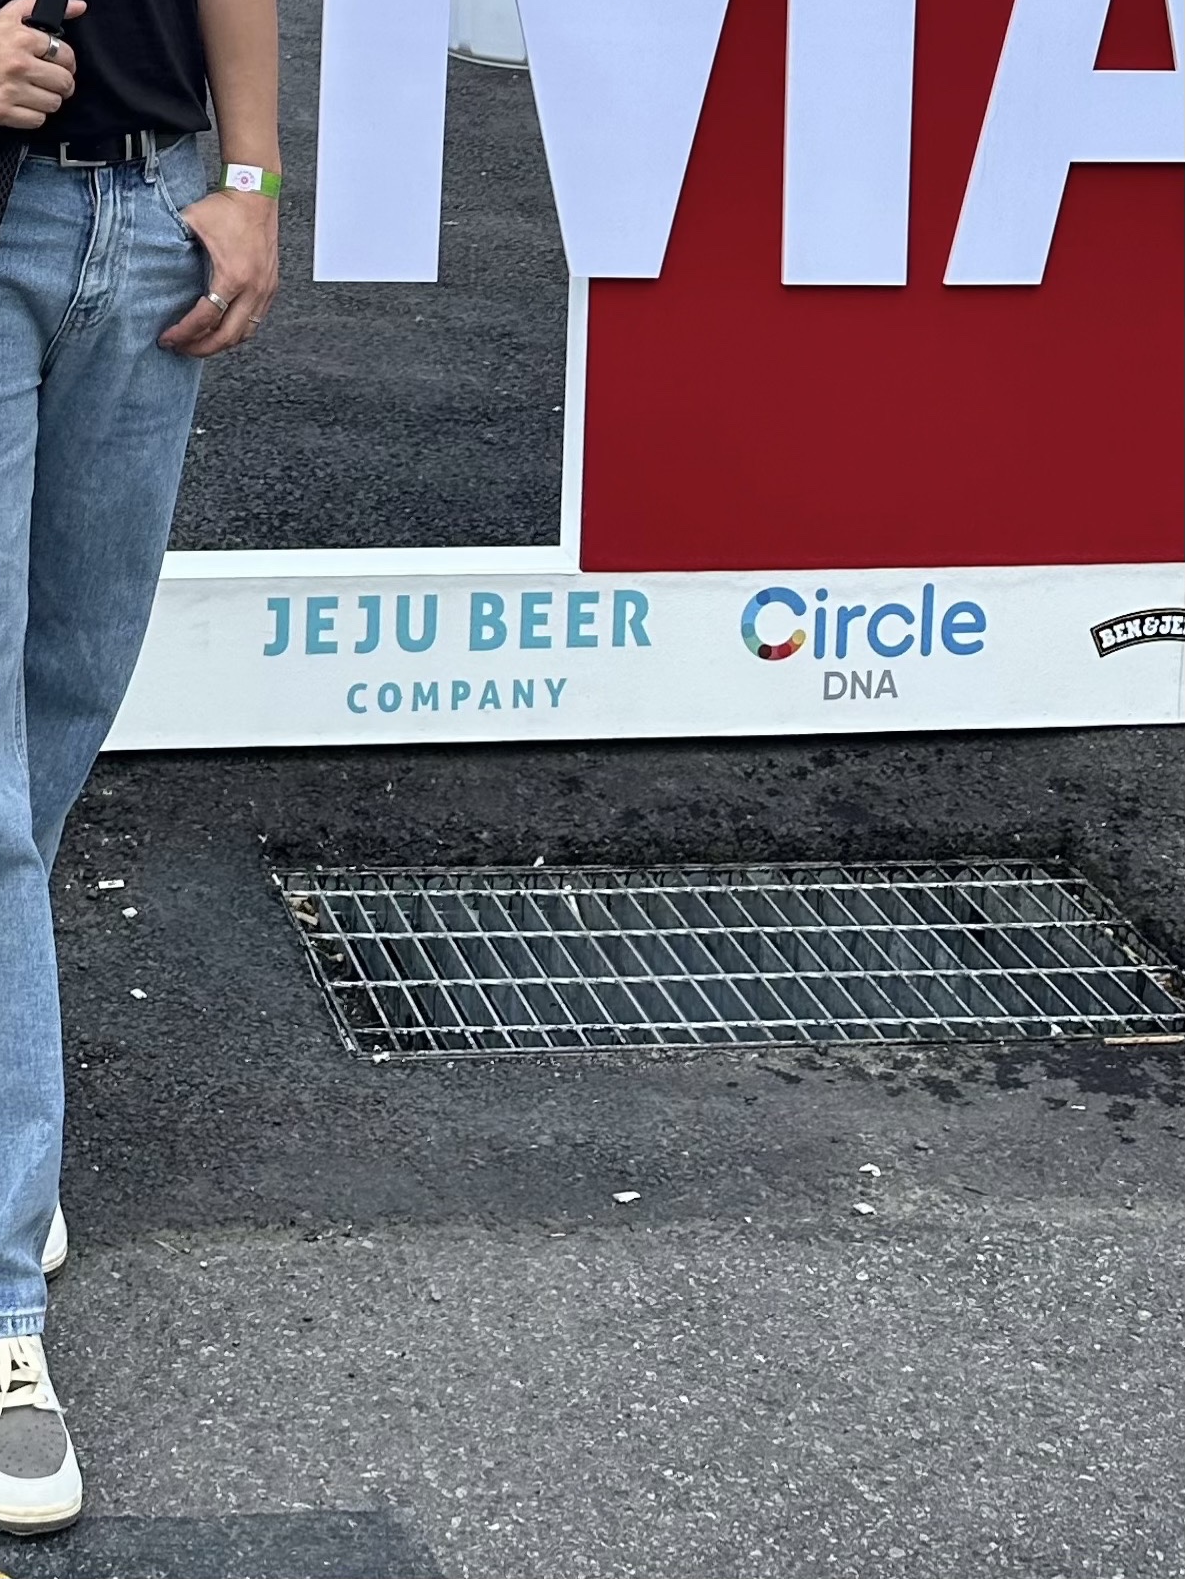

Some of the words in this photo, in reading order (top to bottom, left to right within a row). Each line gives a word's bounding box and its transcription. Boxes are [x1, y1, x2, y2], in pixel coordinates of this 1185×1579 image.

[263, 594, 438, 657] JEJU
[469, 588, 653, 651] BEER
[741, 582, 987, 662] Circle
[347, 677, 569, 715] COMPANY
[823, 670, 900, 701] DNA
